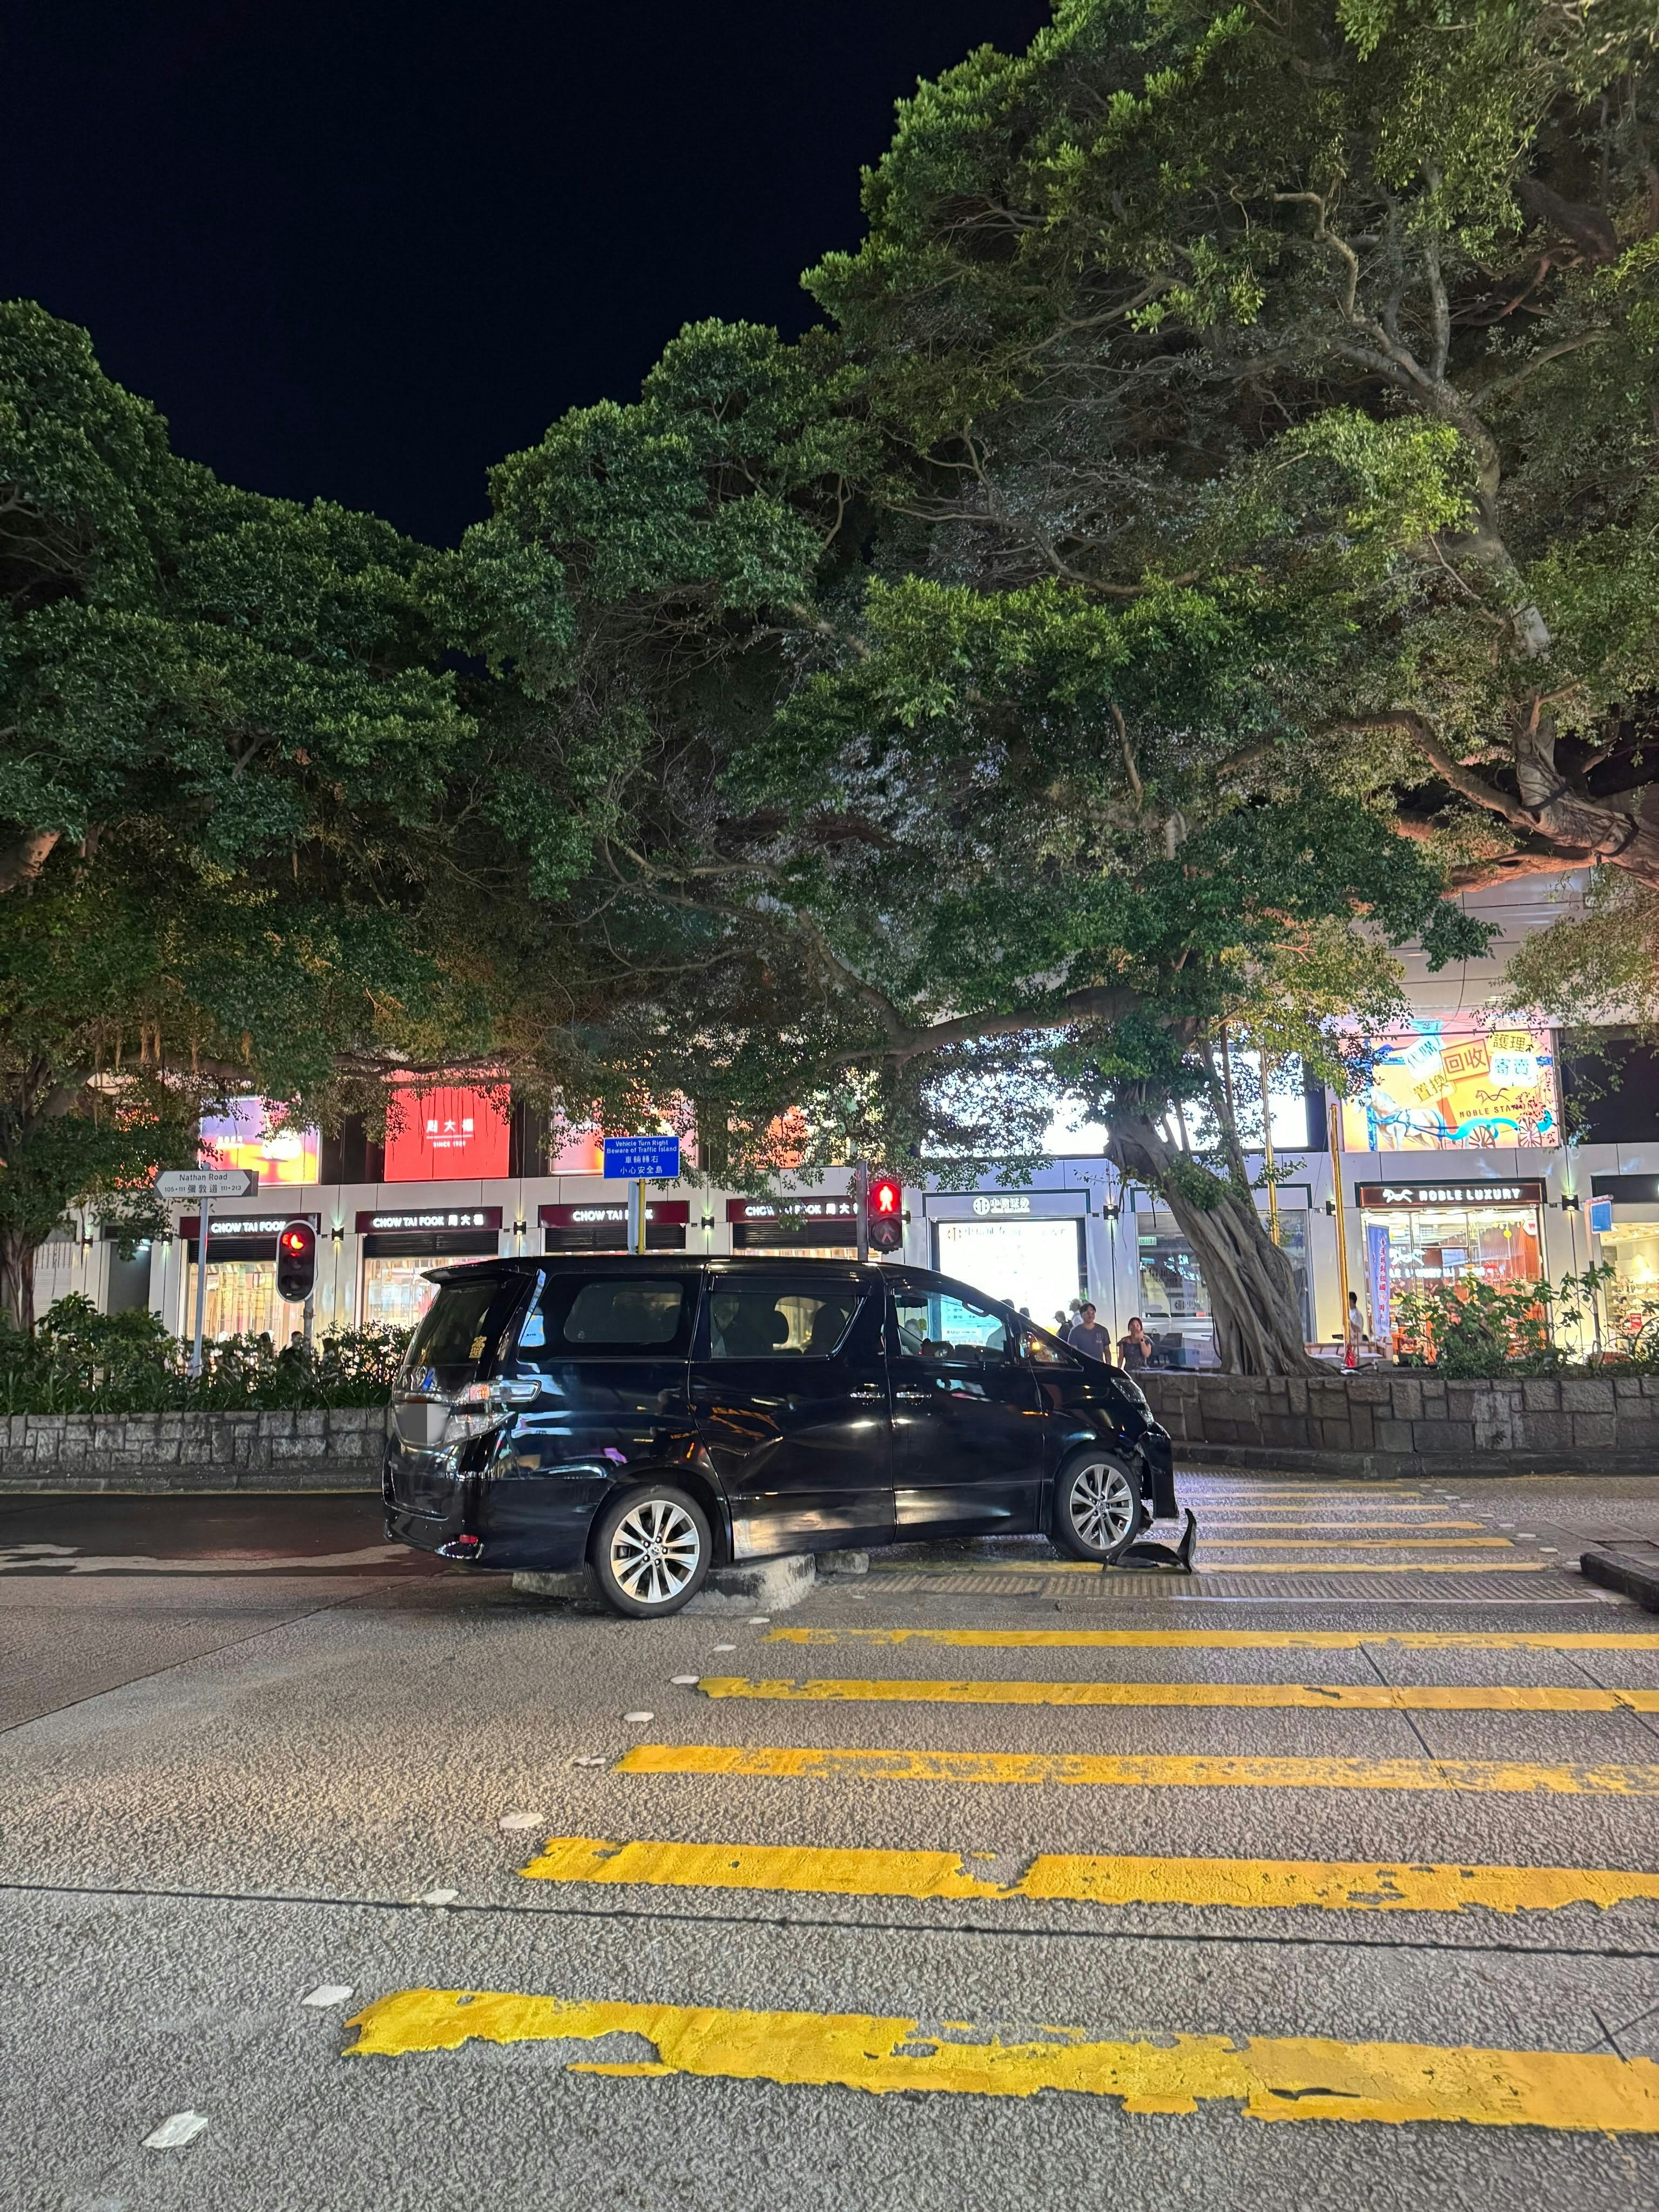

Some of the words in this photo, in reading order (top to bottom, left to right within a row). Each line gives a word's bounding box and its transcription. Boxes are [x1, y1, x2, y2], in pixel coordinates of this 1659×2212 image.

[1493, 1034, 1526, 1052] 護理
[1444, 1048, 1486, 1074] 回收
[1413, 1074, 1449, 1102] 置換
[1460, 1108, 1489, 1118] NOBLE
[625, 1155, 659, 1164] 車輛轉右
[620, 1165, 663, 1175] 小心安全島
[188, 1184, 217, 1193] 彌敦道
[1419, 1189, 1462, 1202] NOBLE
[1466, 1188, 1521, 1201] LUXURY
[572, 1210, 605, 1222] CHOW
[606, 1209, 623, 1220] TAI
[211, 1222, 242, 1233] CHOW
[242, 1222, 258, 1232] TAI
[259, 1221, 286, 1232] FOOK
[373, 1217, 402, 1228] CHOW
[403, 1217, 417, 1226] TAI
[419, 1216, 444, 1226] FOOK
